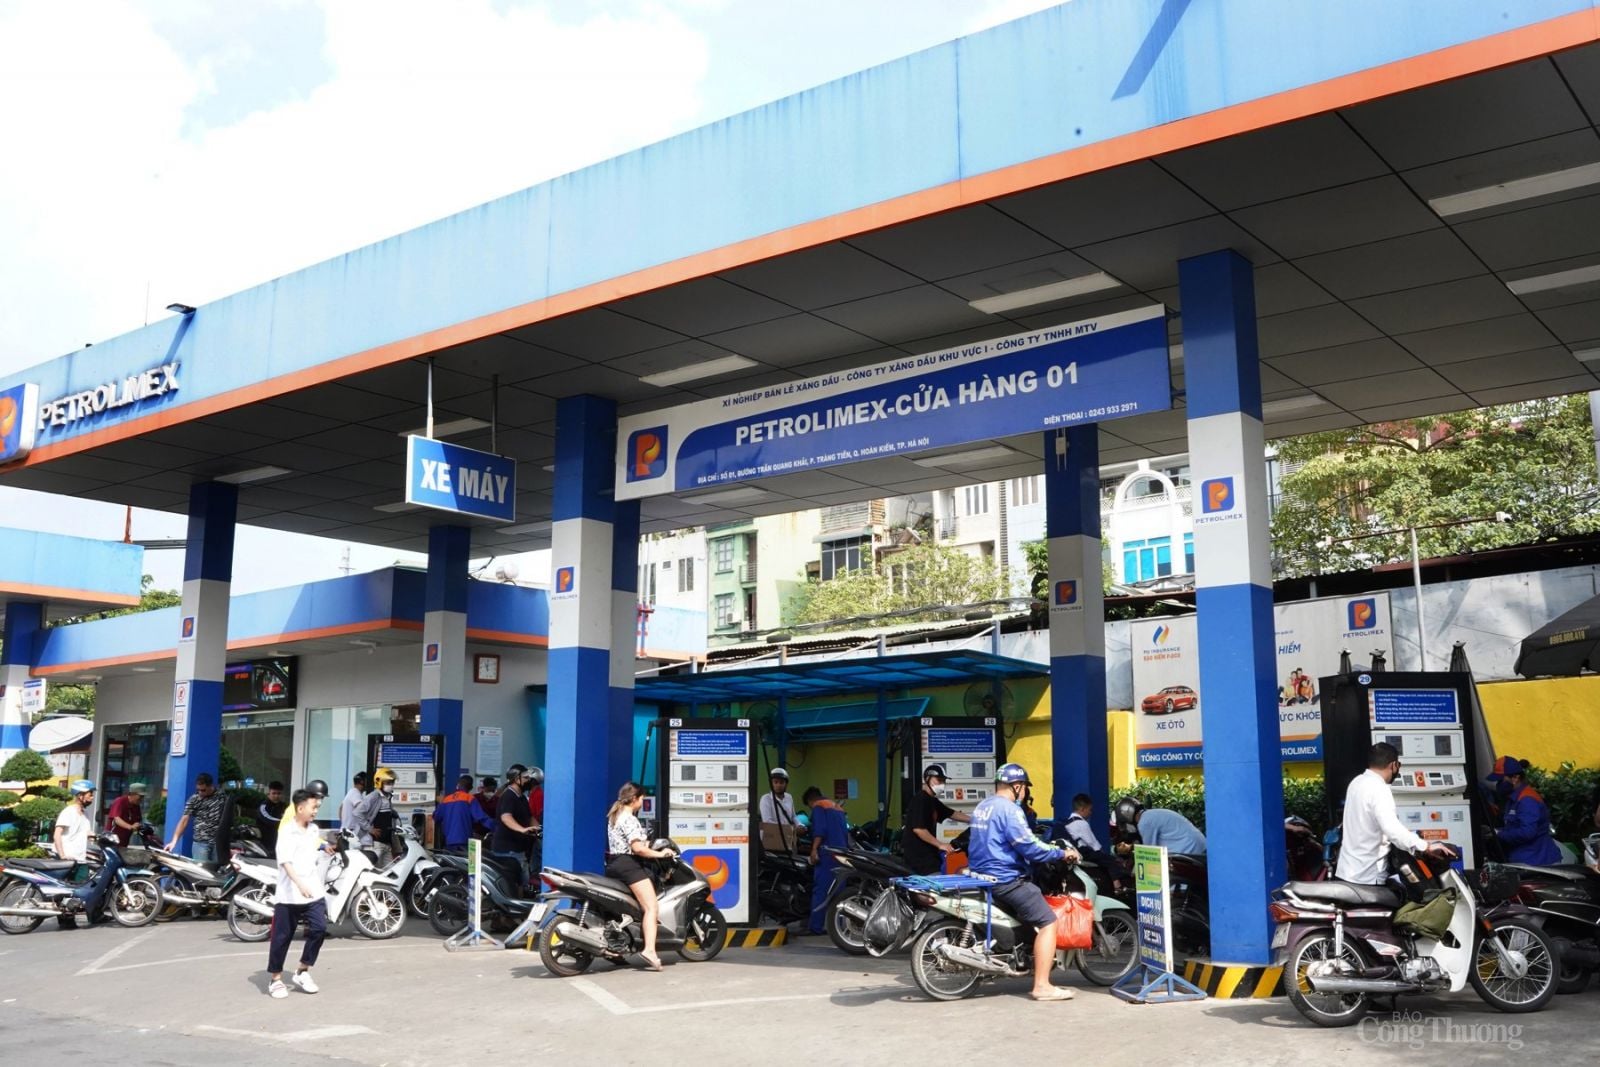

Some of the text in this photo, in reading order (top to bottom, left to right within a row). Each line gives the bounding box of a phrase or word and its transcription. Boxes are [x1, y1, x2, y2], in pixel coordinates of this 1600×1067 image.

[847, 369, 872, 383] CÔNG
[875, 366, 887, 376] TY
[888, 359, 914, 374] XĂNG
[917, 354, 936, 367] DẦU
[939, 350, 959, 362] KHU
[962, 346, 982, 359] VỰC
[984, 346, 988, 354] I
[997, 338, 1025, 352] CÔNG
[1028, 335, 1040, 345] TY
[1043, 328, 1072, 342] TNHH
[1075, 322, 1098, 335] MTV
[38, 362, 180, 431] PETROLIMEX
[735, 362, 1079, 447] PETROLIMEX-CỬA HÀNG 01
[1088, 407, 1105, 418] 0243
[1107, 405, 1119, 415] 933
[1120, 402, 1138, 412] 2971
[772, 462, 793, 472] QUANG
[897, 442, 906, 450] TP.
[420, 458, 509, 504] XE MÁY
[1195, 513, 1243, 524] PETROLIMEX
[1342, 629, 1385, 639] PETROLIMEX
[1279, 712, 1294, 722] ỨC
[1156, 720, 1185, 731] XE ÔTÔ
[1161, 751, 1183, 761] CÔNG
[1184, 752, 1194, 760] TY
[1281, 746, 1318, 756] ROLIMEX
